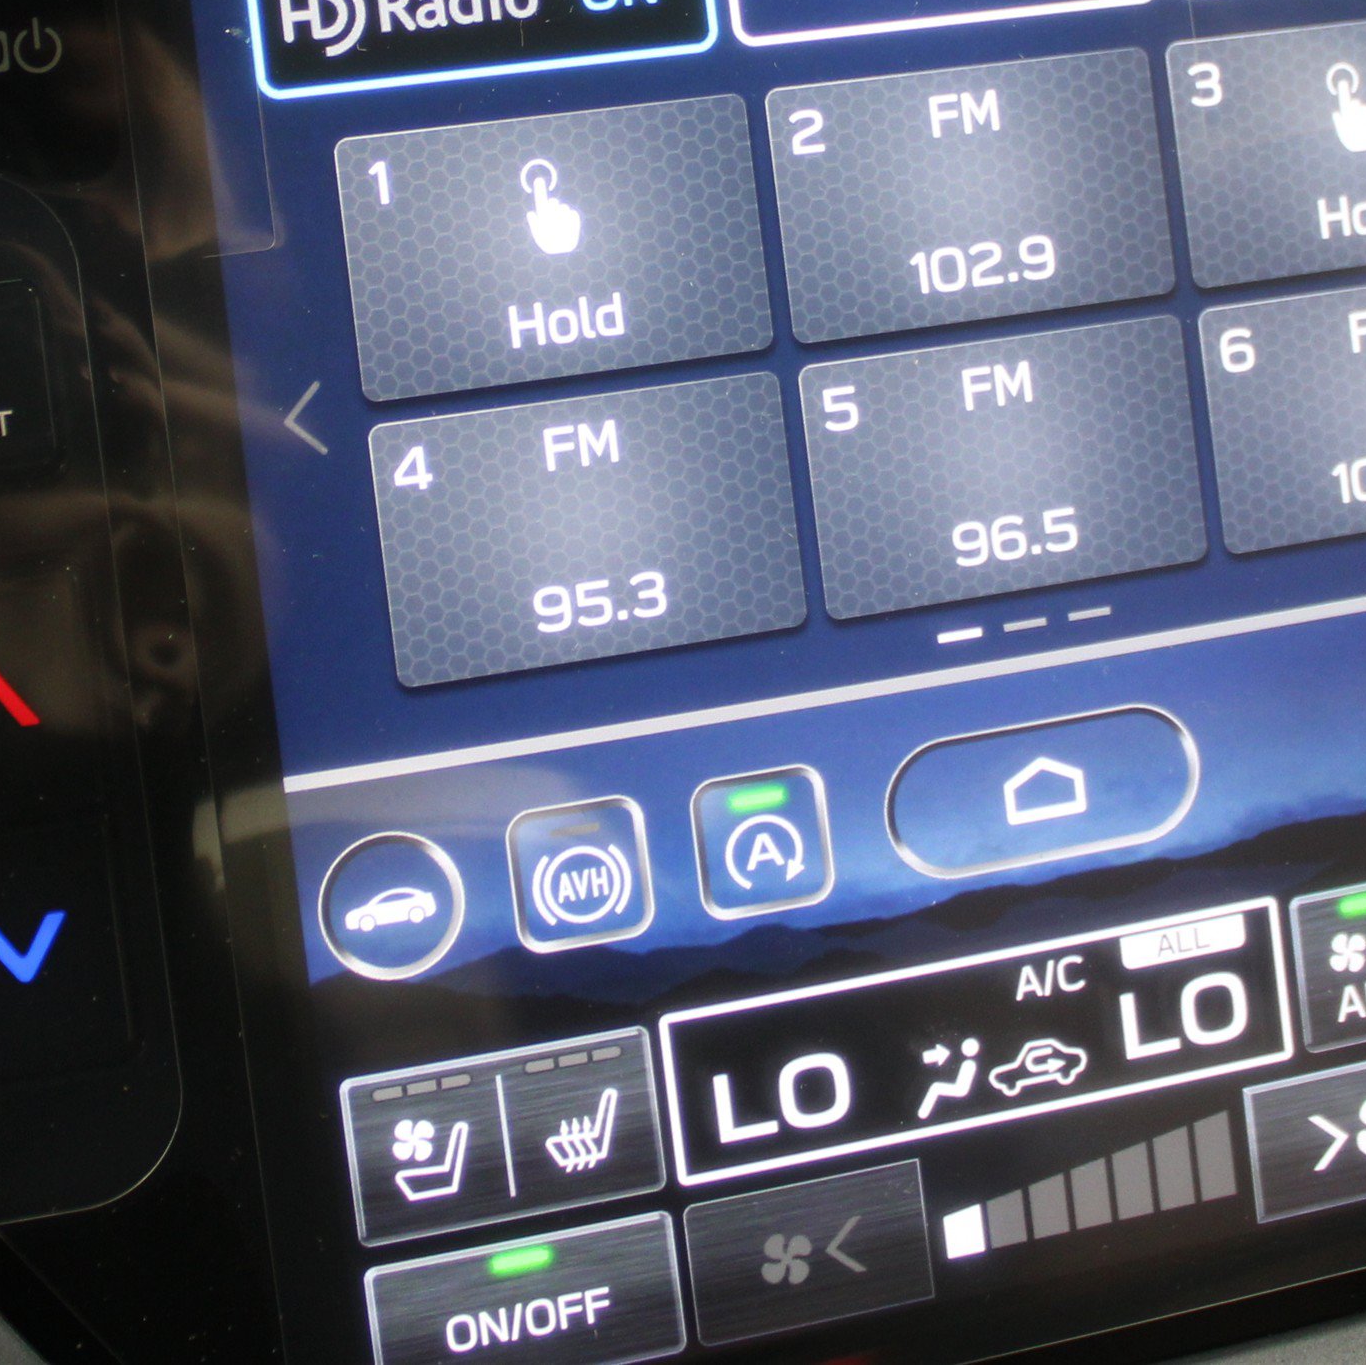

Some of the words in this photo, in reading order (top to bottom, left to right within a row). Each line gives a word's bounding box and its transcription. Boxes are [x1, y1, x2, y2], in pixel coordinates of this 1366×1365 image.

[1187, 62, 1223, 108] 3
[788, 108, 826, 156] 2
[927, 88, 1001, 139] FM
[367, 158, 394, 206] 1
[909, 234, 1056, 295] 102.9
[507, 290, 626, 350] Hold
[1219, 327, 1256, 374] 6
[822, 385, 860, 433] 5
[961, 360, 1033, 412] FM
[392, 442, 434, 492] 4
[542, 418, 621, 472] FM
[951, 506, 1079, 567] 96.5
[532, 570, 668, 634] 95.3
[557, 865, 610, 905] AVH
[1158, 927, 1211, 958] ALL
[1014, 954, 1087, 1002] A/C
[1119, 970, 1249, 1061] LO
[712, 1051, 852, 1144] LO
[445, 1286, 610, 1353] ON/OFF
